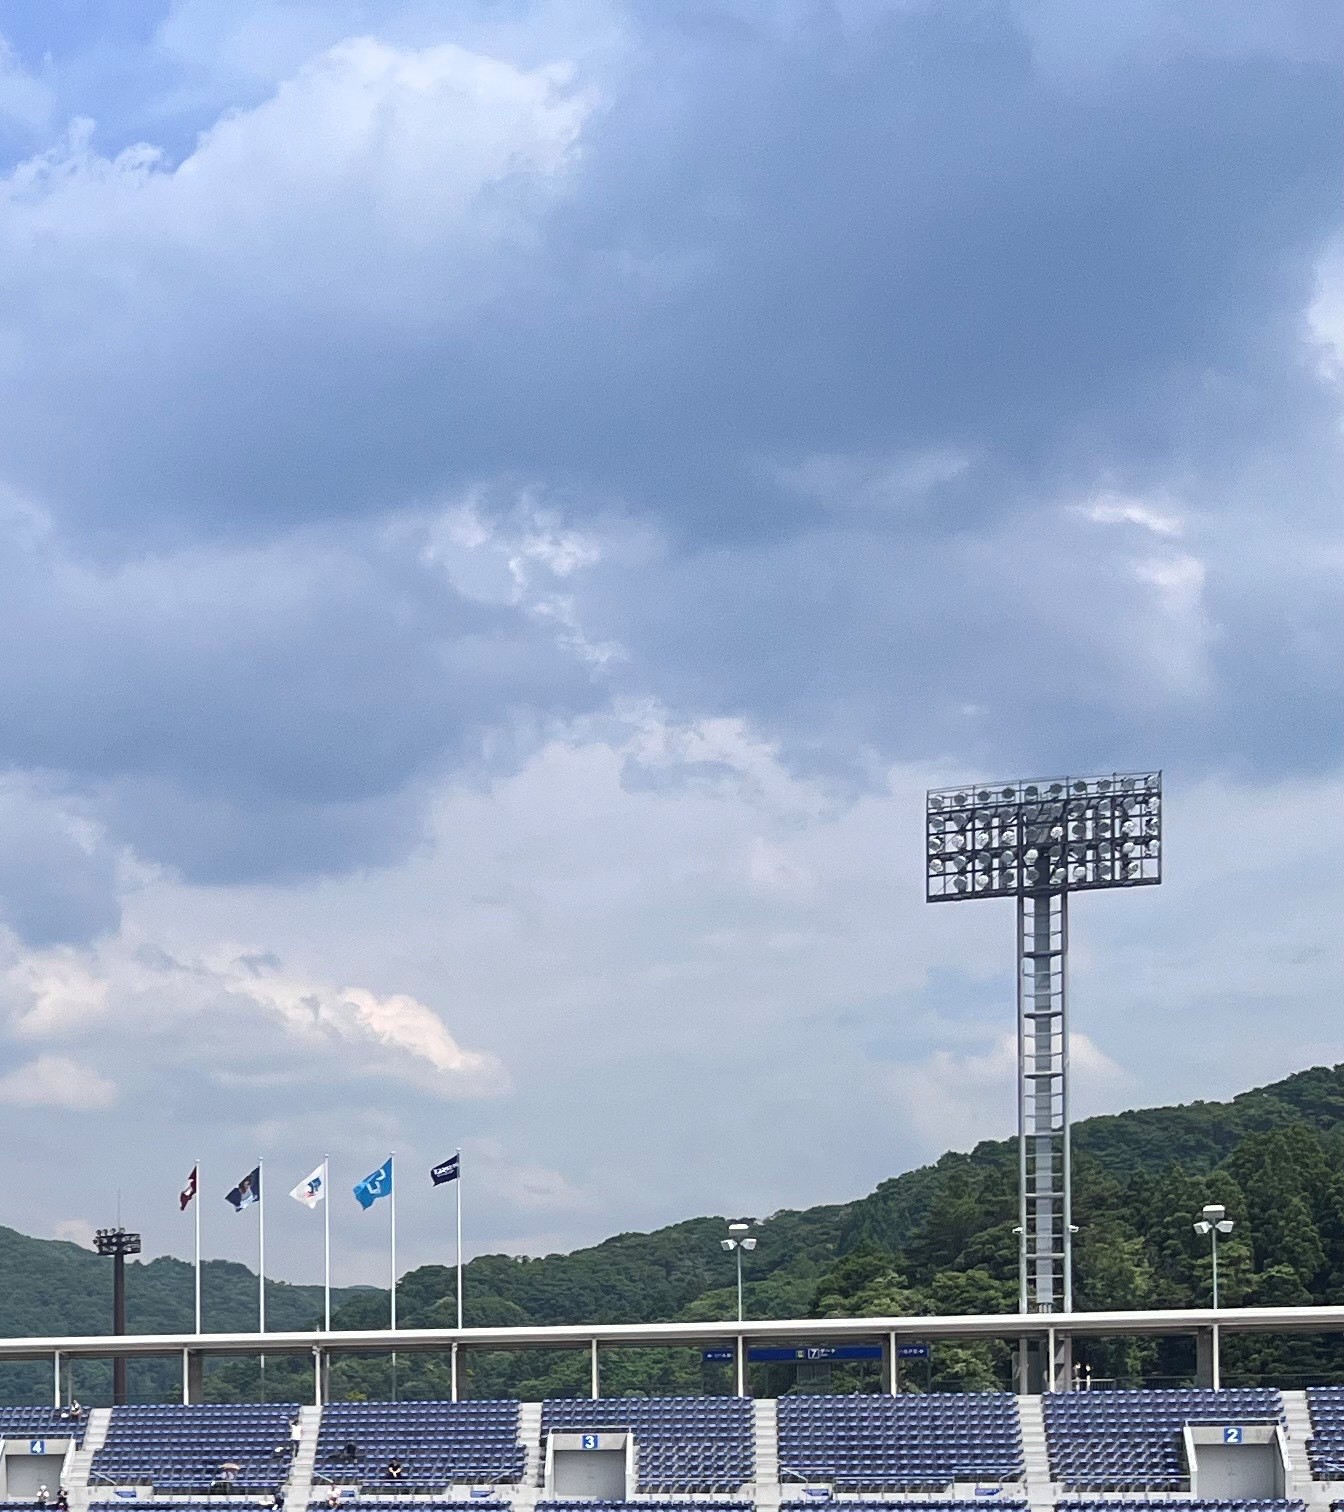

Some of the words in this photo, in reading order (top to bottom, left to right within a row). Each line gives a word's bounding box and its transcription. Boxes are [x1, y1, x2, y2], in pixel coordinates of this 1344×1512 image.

[585, 1435, 595, 1449] 3
[1227, 1429, 1239, 1443] 2
[32, 1441, 42, 1453] 4
